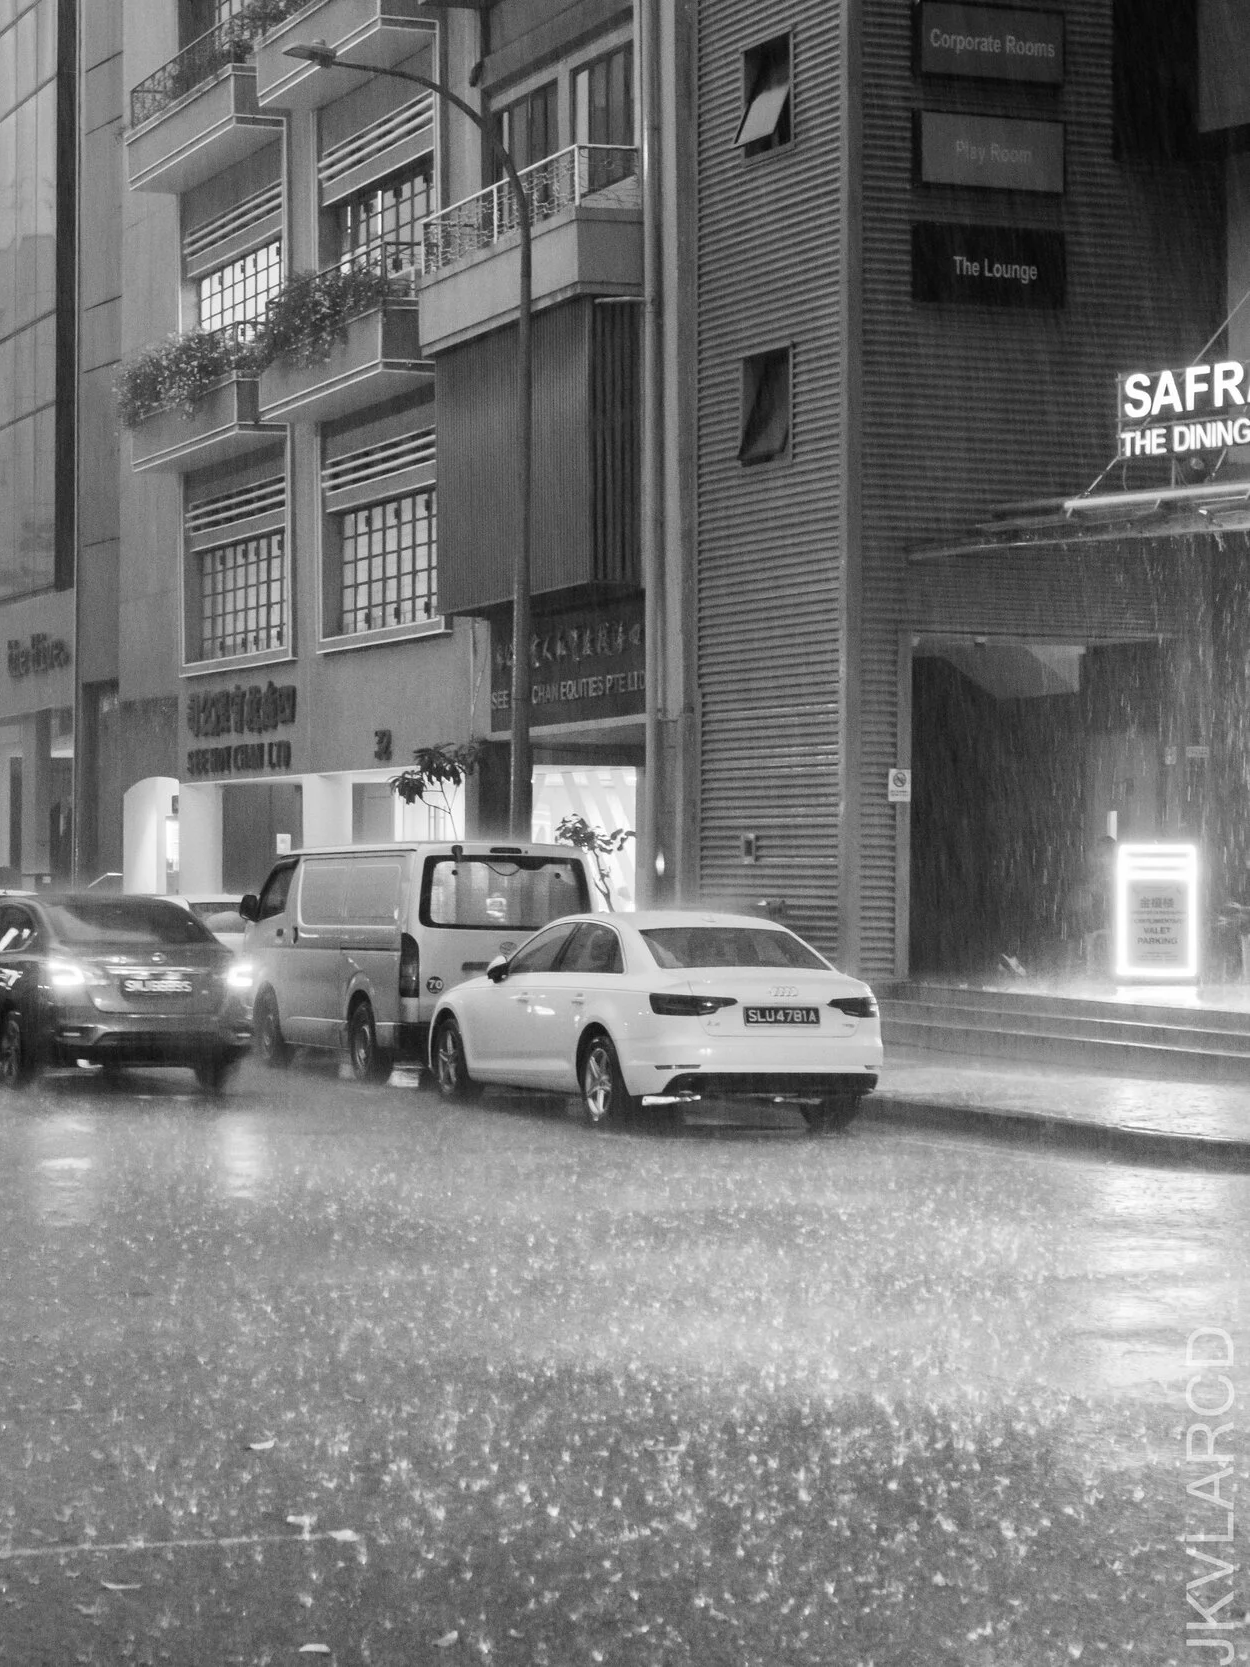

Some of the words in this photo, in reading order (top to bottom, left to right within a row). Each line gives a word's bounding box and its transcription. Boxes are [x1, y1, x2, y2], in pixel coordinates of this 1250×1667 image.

[930, 28, 1002, 54] Corporate
[1005, 34, 1056, 58] Rooms
[956, 140, 986, 165] Play
[990, 143, 1033, 163] Room
[953, 255, 980, 277] The
[984, 258, 1038, 284] Lounge
[1124, 361, 1250, 418] SAFR
[1120, 428, 1168, 457] THE
[1173, 417, 1250, 452] DINING
[1136, 937, 1178, 945] PARKING
[429, 979, 443, 989] 70
